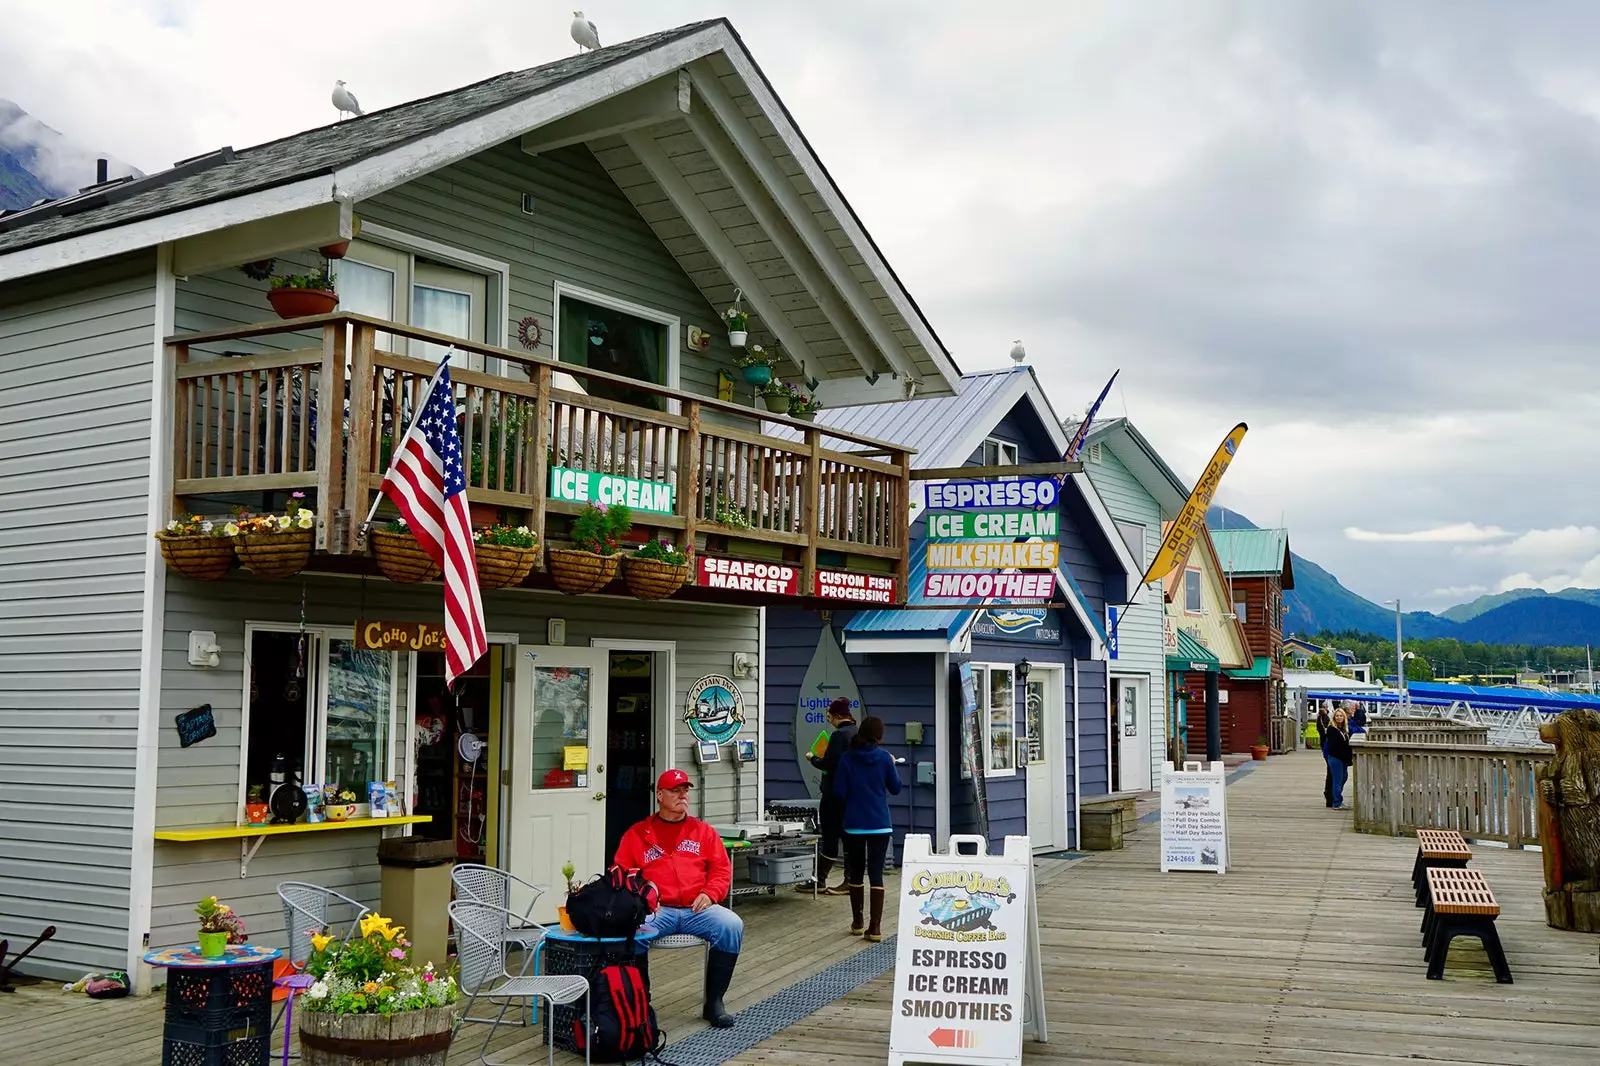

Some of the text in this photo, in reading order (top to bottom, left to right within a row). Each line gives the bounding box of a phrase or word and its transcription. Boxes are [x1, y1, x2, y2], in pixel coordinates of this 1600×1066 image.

[553, 469, 671, 513] ICE CREAM
[928, 481, 1055, 508] ESPRESSO
[1167, 461, 1219, 551] ONLY 95.00
[929, 512, 1056, 538] ICE CREAM
[1188, 508, 1206, 536] THE
[929, 543, 1055, 567] MILKSHAKES
[704, 558, 793, 580] SEAFOOD
[819, 571, 892, 590] CUSTOM FISH
[709, 574, 788, 594] MARKET
[821, 585, 890, 603] PROCESSING
[927, 575, 1053, 597] SMOOTHEE
[364, 621, 447, 650] COHO JOE'S
[692, 678, 721, 701] CAPTAIN
[804, 711, 825, 723] Gift
[911, 870, 1011, 899] COHO JOE'S
[914, 926, 1007, 943] DOCKSIDE COFFEE BAR
[912, 949, 1007, 970] ESPRESSO
[908, 974, 1009, 996] ICE CREAM
[901, 999, 1012, 1022] SMOOTHIES
